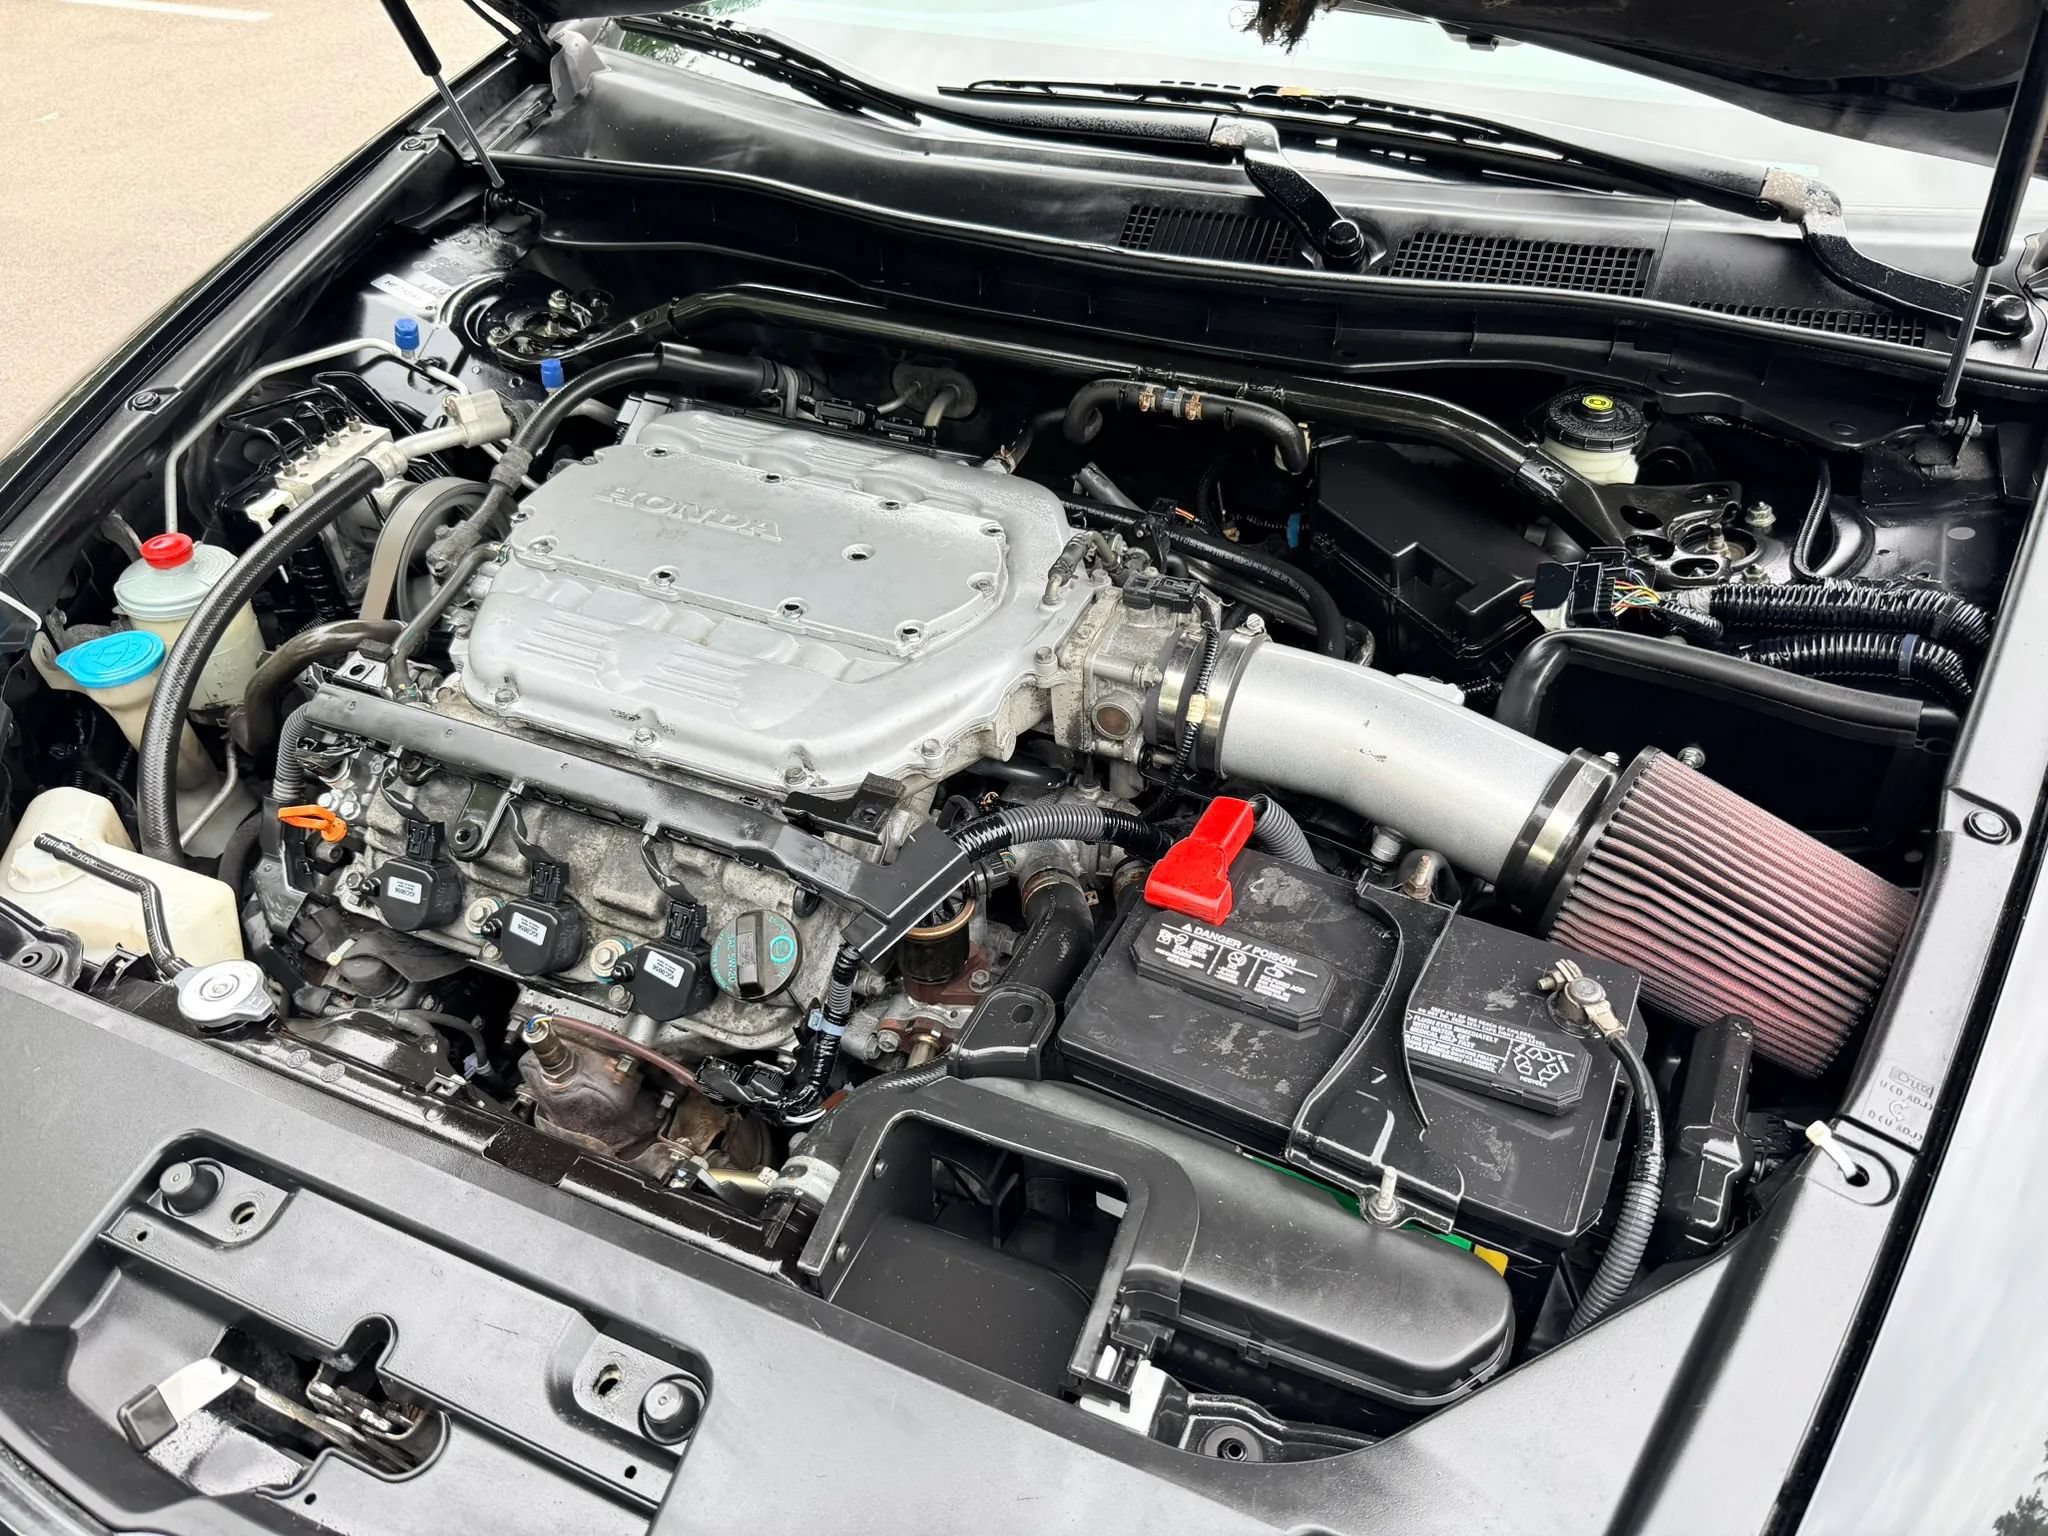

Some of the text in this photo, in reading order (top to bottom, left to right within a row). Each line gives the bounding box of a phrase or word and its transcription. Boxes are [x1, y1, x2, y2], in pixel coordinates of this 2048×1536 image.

[593, 487, 783, 543] HONDA
[1194, 927, 1241, 948] DANGER
[1252, 946, 1297, 966] POISON
[1519, 1075, 1548, 1089] RECYCLE
